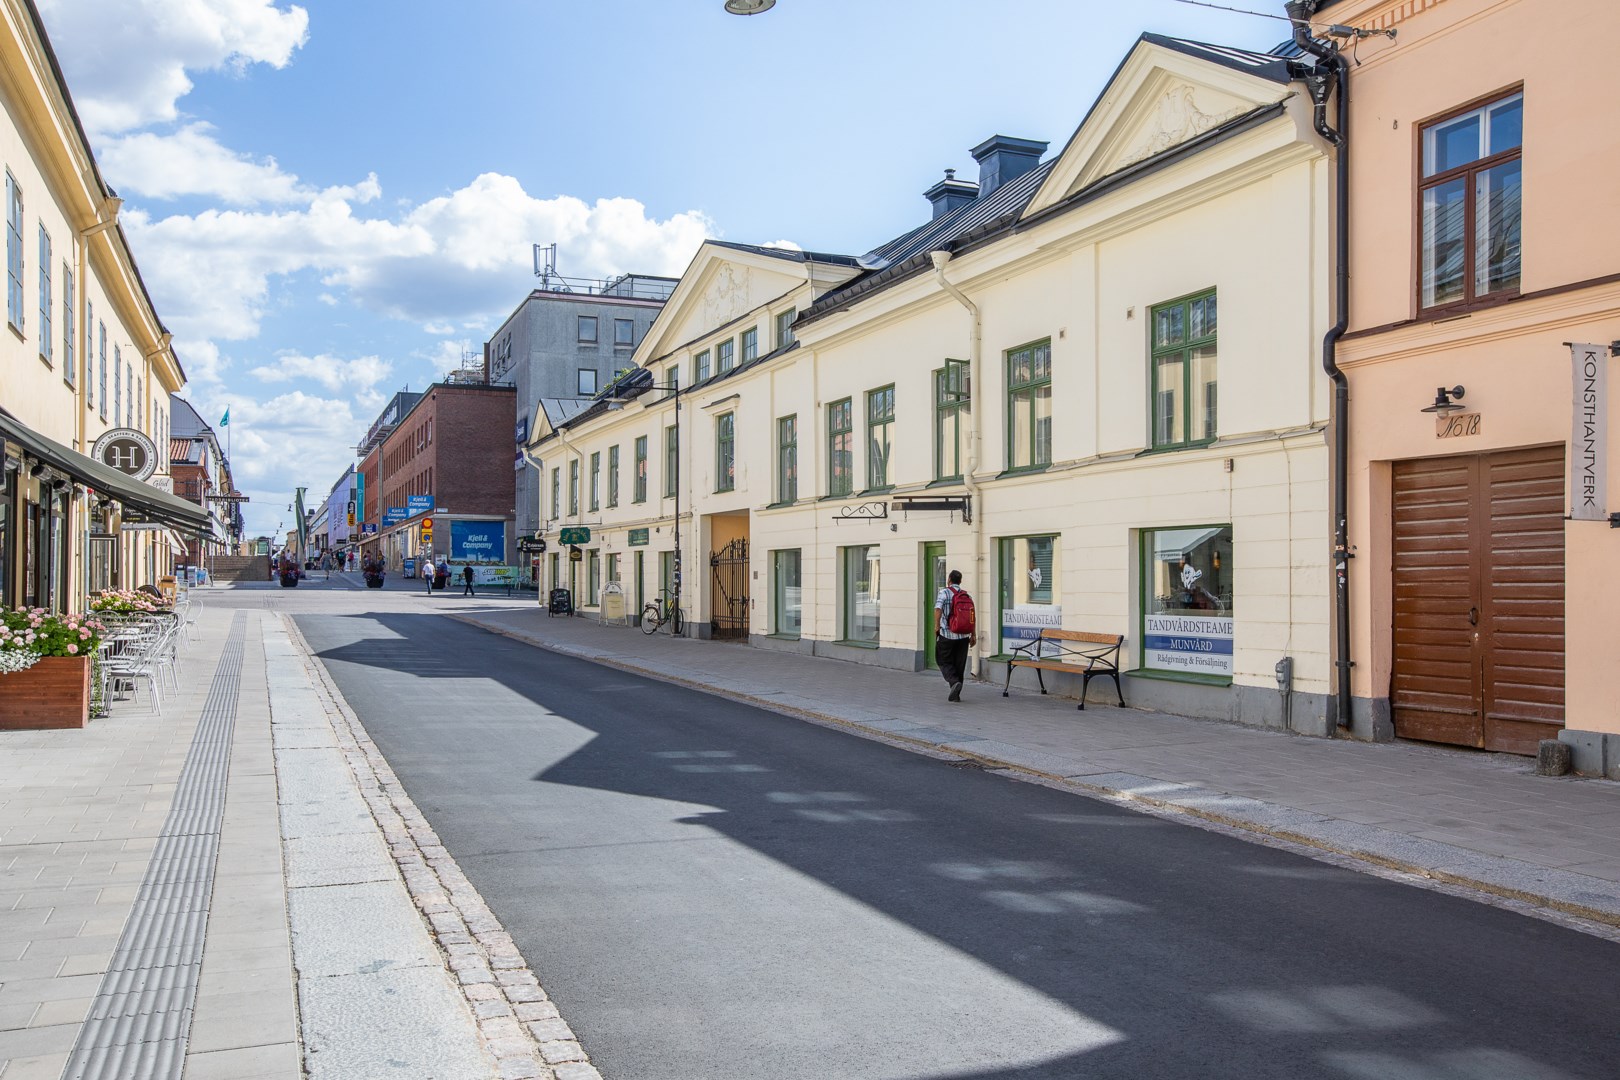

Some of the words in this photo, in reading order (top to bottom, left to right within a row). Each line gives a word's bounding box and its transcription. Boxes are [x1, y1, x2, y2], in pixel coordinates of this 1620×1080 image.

[1465, 413, 1481, 436] 18
[1583, 351, 1597, 508] KONSTHANTVERK
[112, 446, 138, 468] H
[467, 534, 483, 542] Kjell
[482, 568, 511, 576] SUBWAY
[1170, 639, 1212, 651] MUNVÅRD
[1157, 653, 1188, 667] Rådgivning
[1189, 657, 1195, 665] &
[1195, 657, 1228, 670] Försäljning
